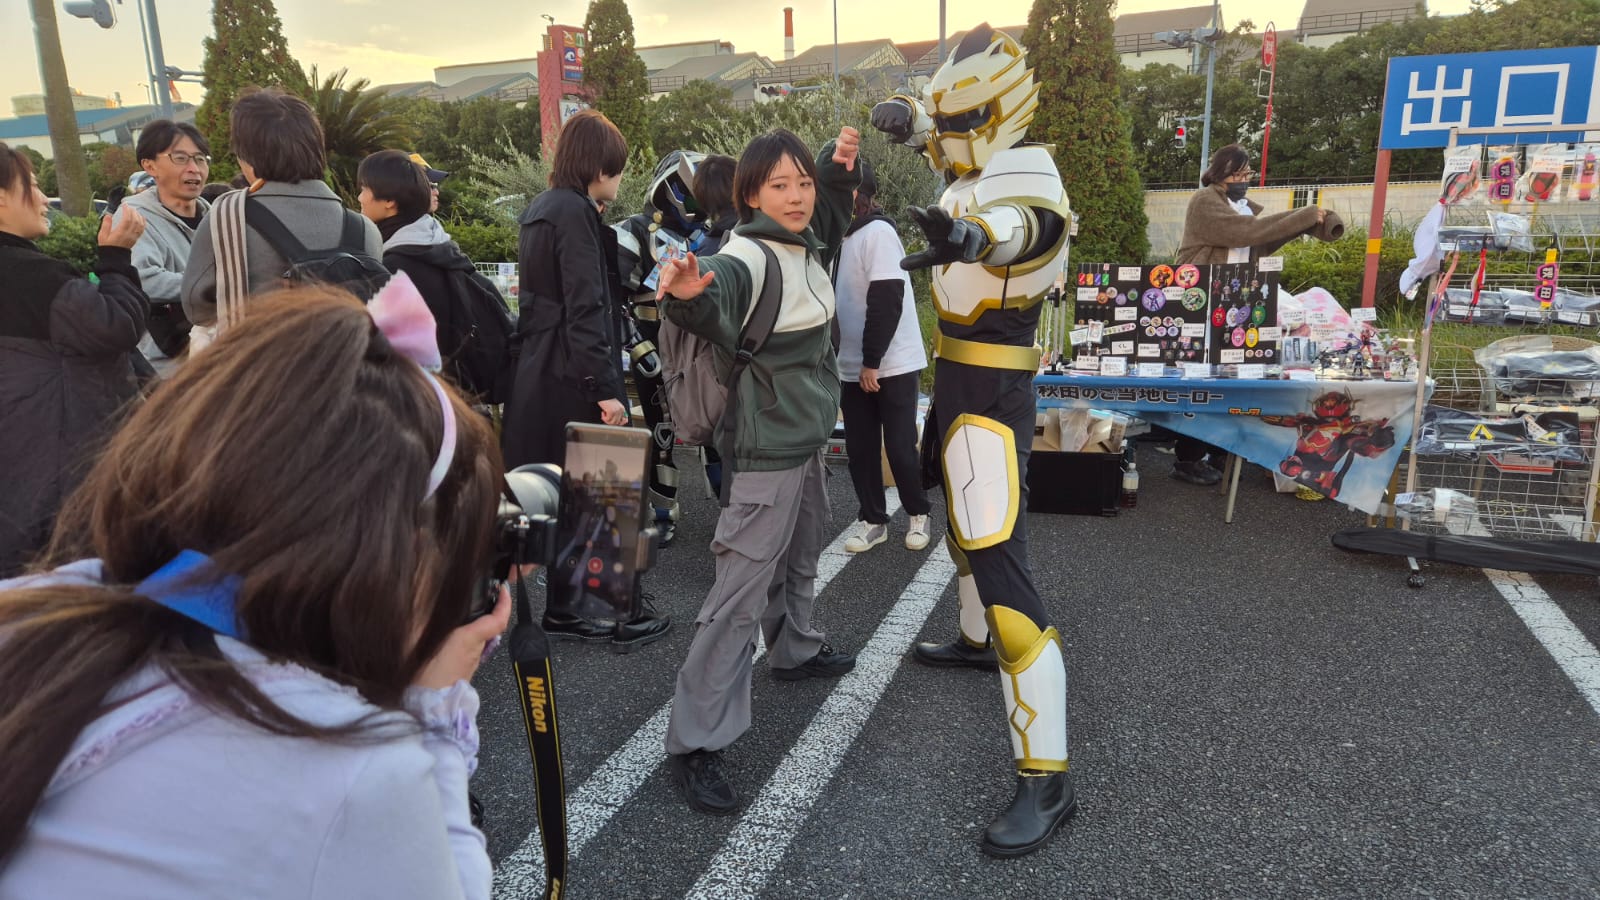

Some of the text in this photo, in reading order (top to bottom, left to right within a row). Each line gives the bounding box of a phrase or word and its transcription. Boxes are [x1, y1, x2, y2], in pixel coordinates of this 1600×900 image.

[1401, 63, 1570, 135] 出口
[1500, 165, 1510, 196] 秋田
[1541, 267, 1553, 298] 秋田
[1037, 385, 1224, 404] 秋田のご当地ヒーロー
[526, 676, 548, 733] Nikon
